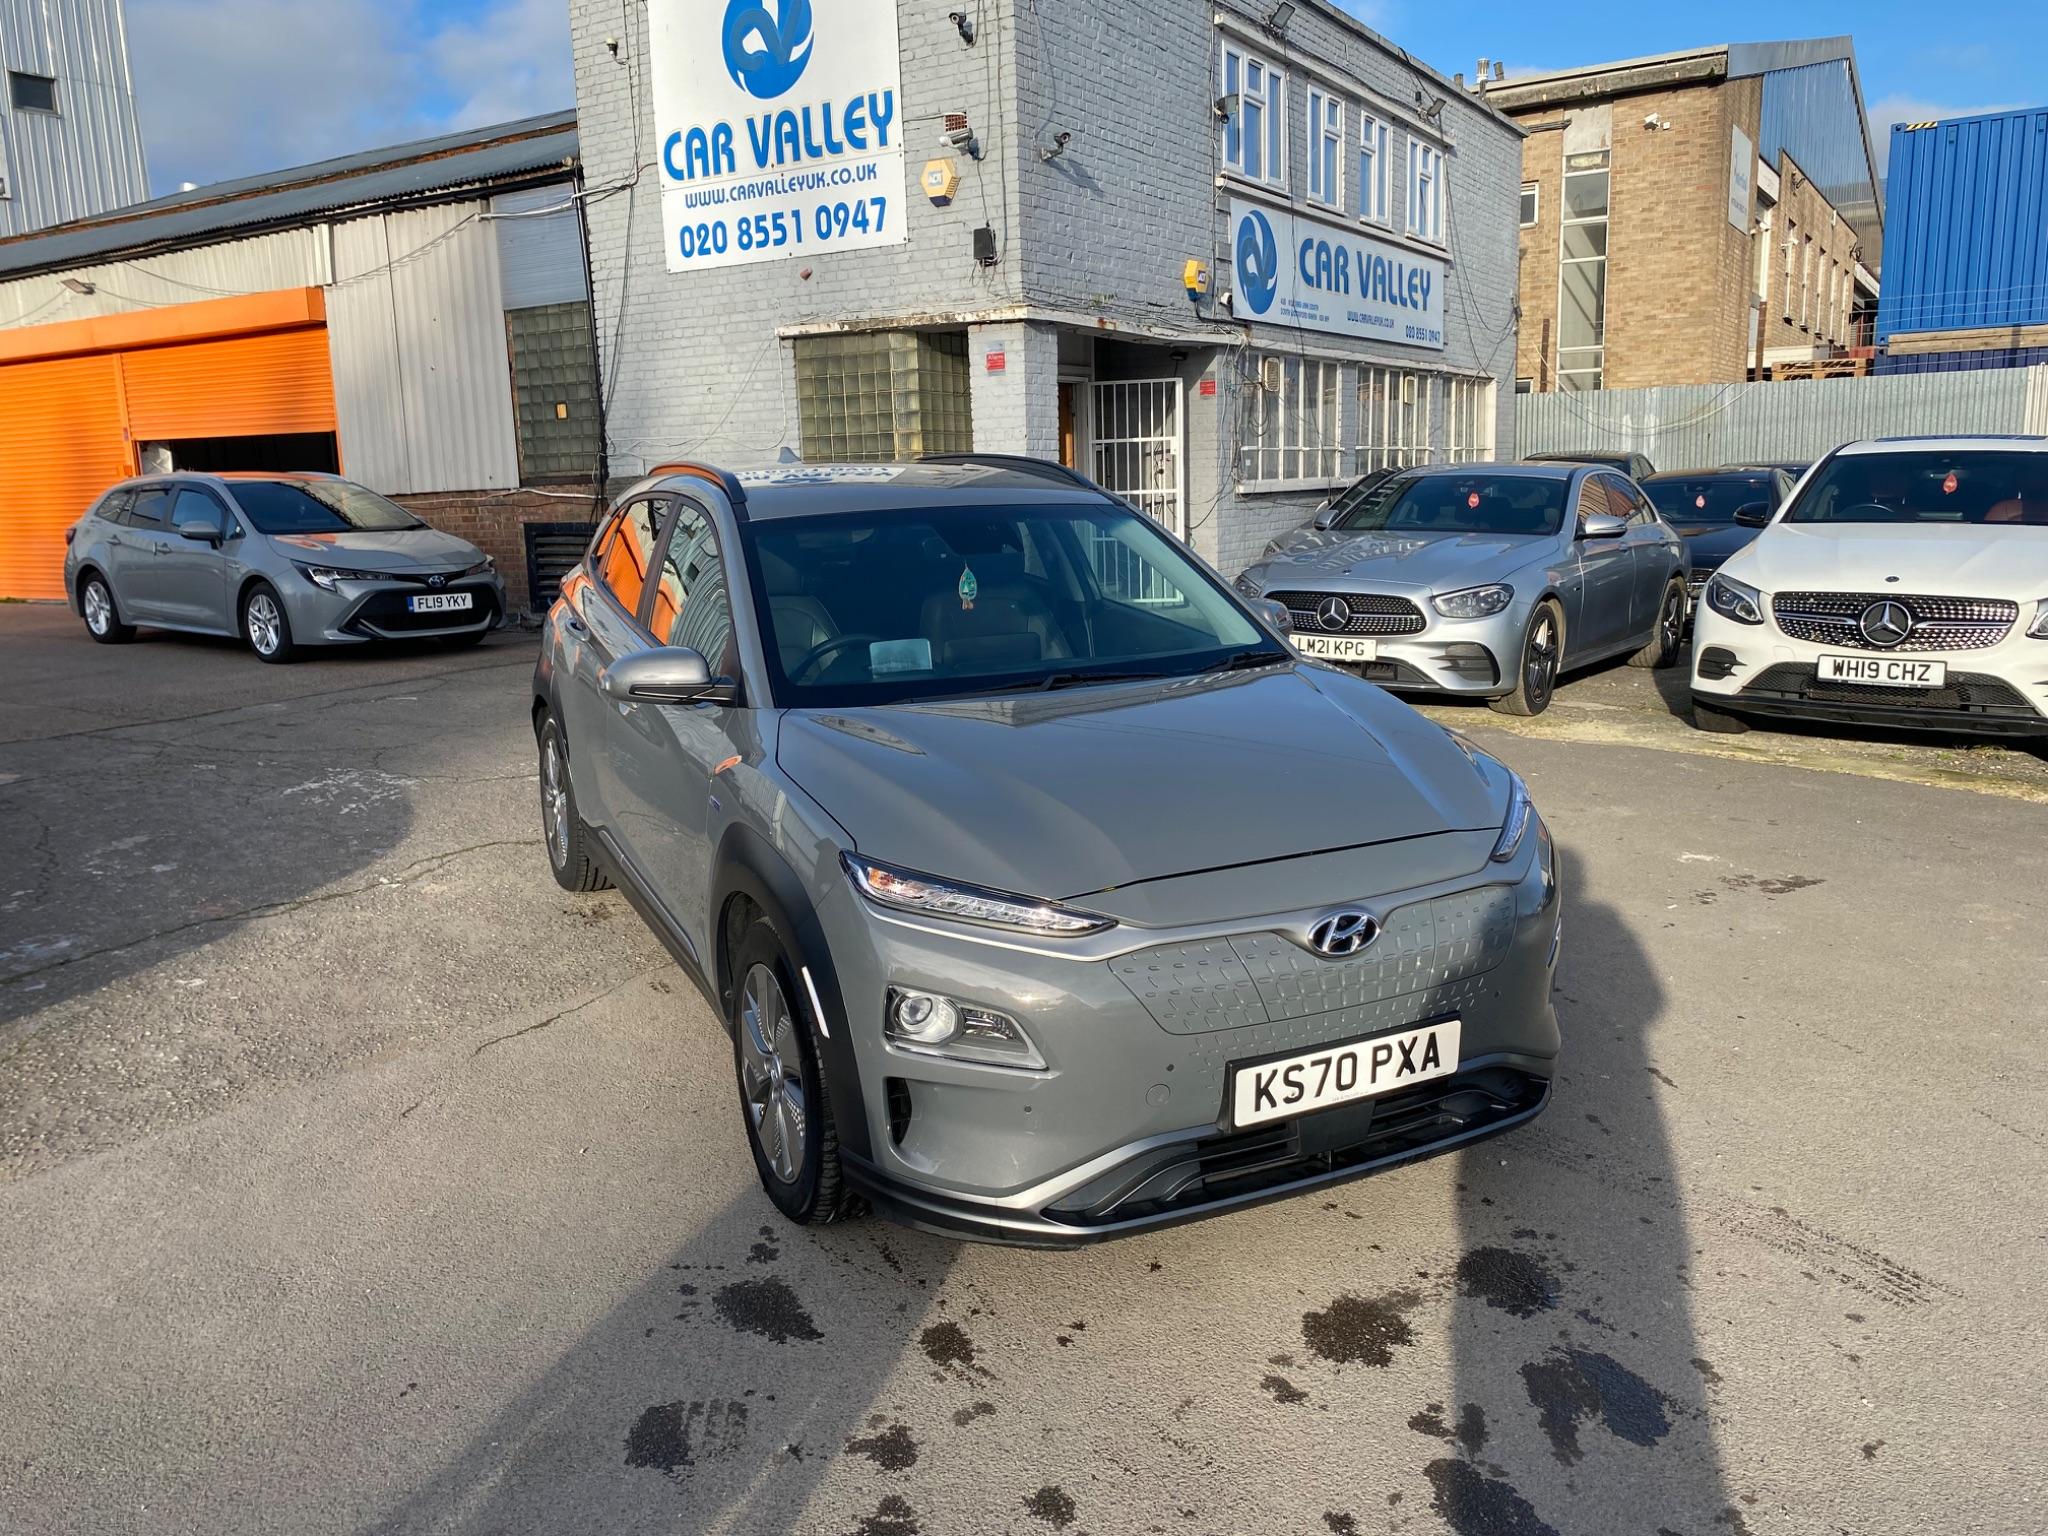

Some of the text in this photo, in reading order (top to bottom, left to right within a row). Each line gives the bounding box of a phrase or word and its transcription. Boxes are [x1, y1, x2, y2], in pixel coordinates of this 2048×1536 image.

[663, 90, 894, 182] CAR VALLEY
[685, 163, 877, 209] WWW.CARVALLEYUK.CO.UK
[679, 196, 886, 258] 020 8551 0947
[1299, 237, 1431, 312] CAR VALLEY
[1405, 325, 1440, 343] 020 8551 0947
[417, 595, 467, 609] FL19 YKY
[1297, 637, 1365, 656] LM21 KPG
[1832, 658, 1931, 682] WH19 CHZ
[1253, 1031, 1441, 1112] KS70 PXA
